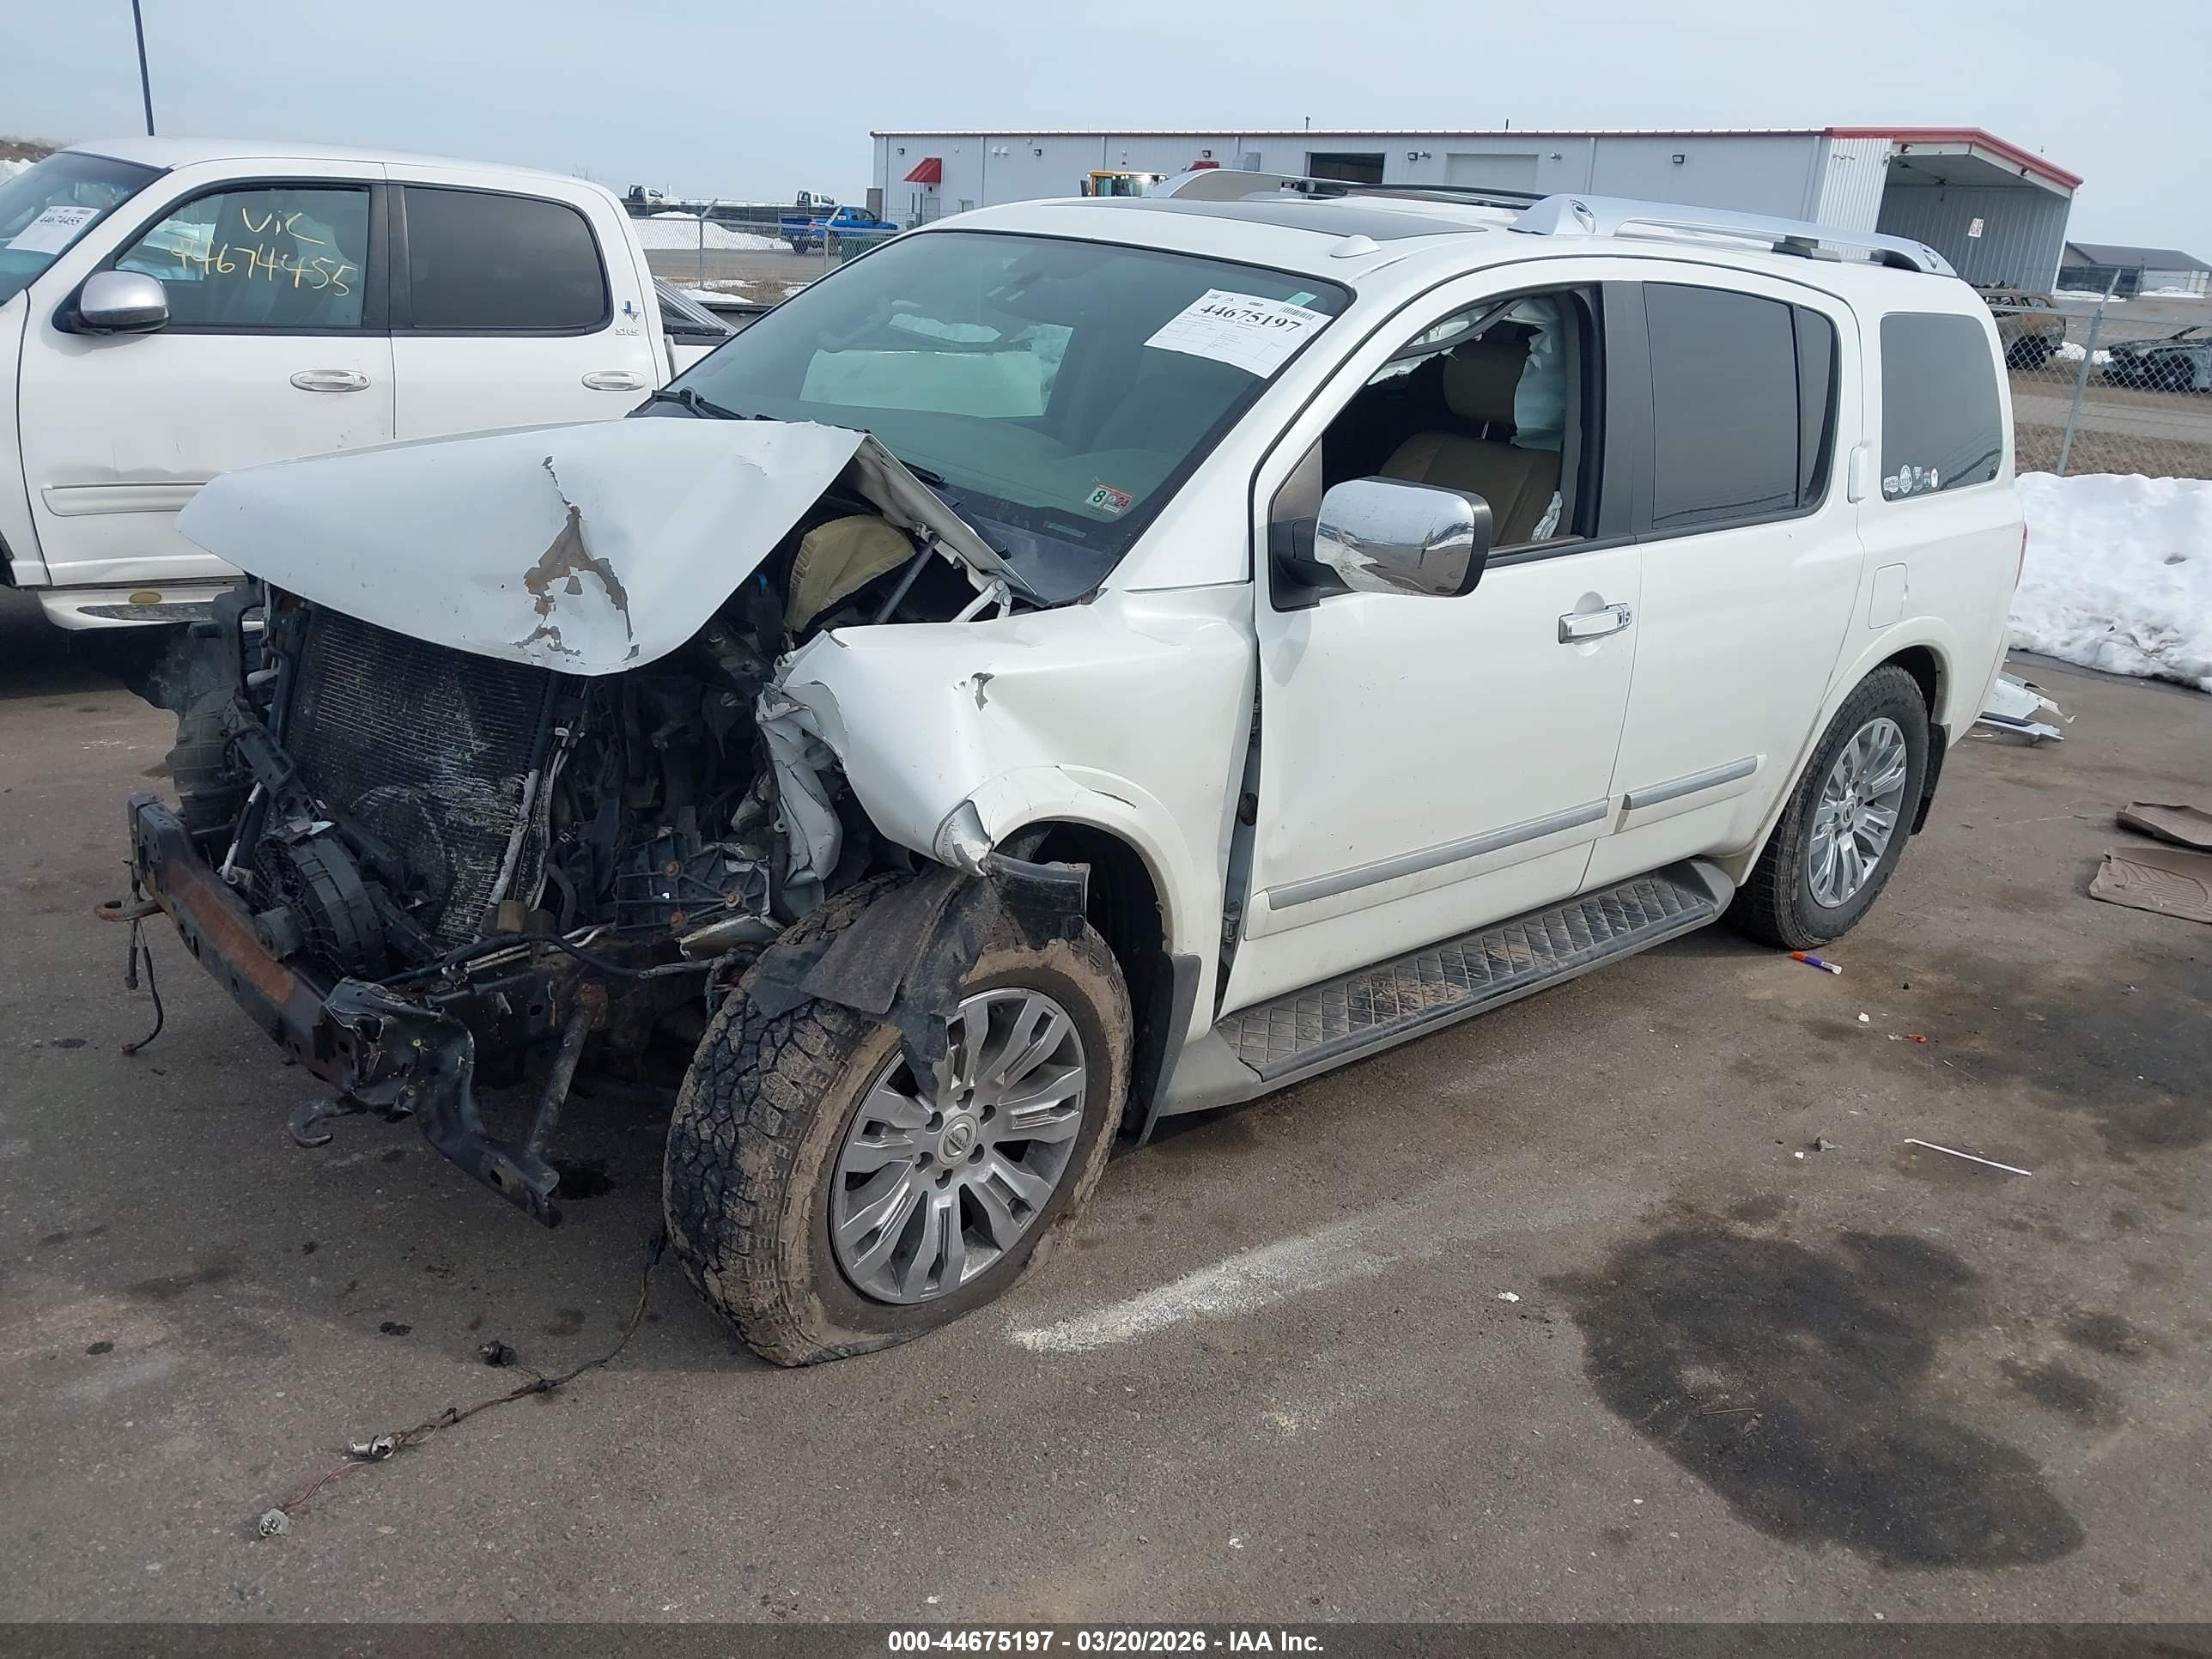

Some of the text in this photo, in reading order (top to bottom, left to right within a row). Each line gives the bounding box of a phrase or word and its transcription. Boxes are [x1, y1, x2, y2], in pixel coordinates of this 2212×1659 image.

[170, 238, 358, 296] 44674455
[1200, 303, 1303, 332] 44675197
[1092, 490, 1106, 502] 8
